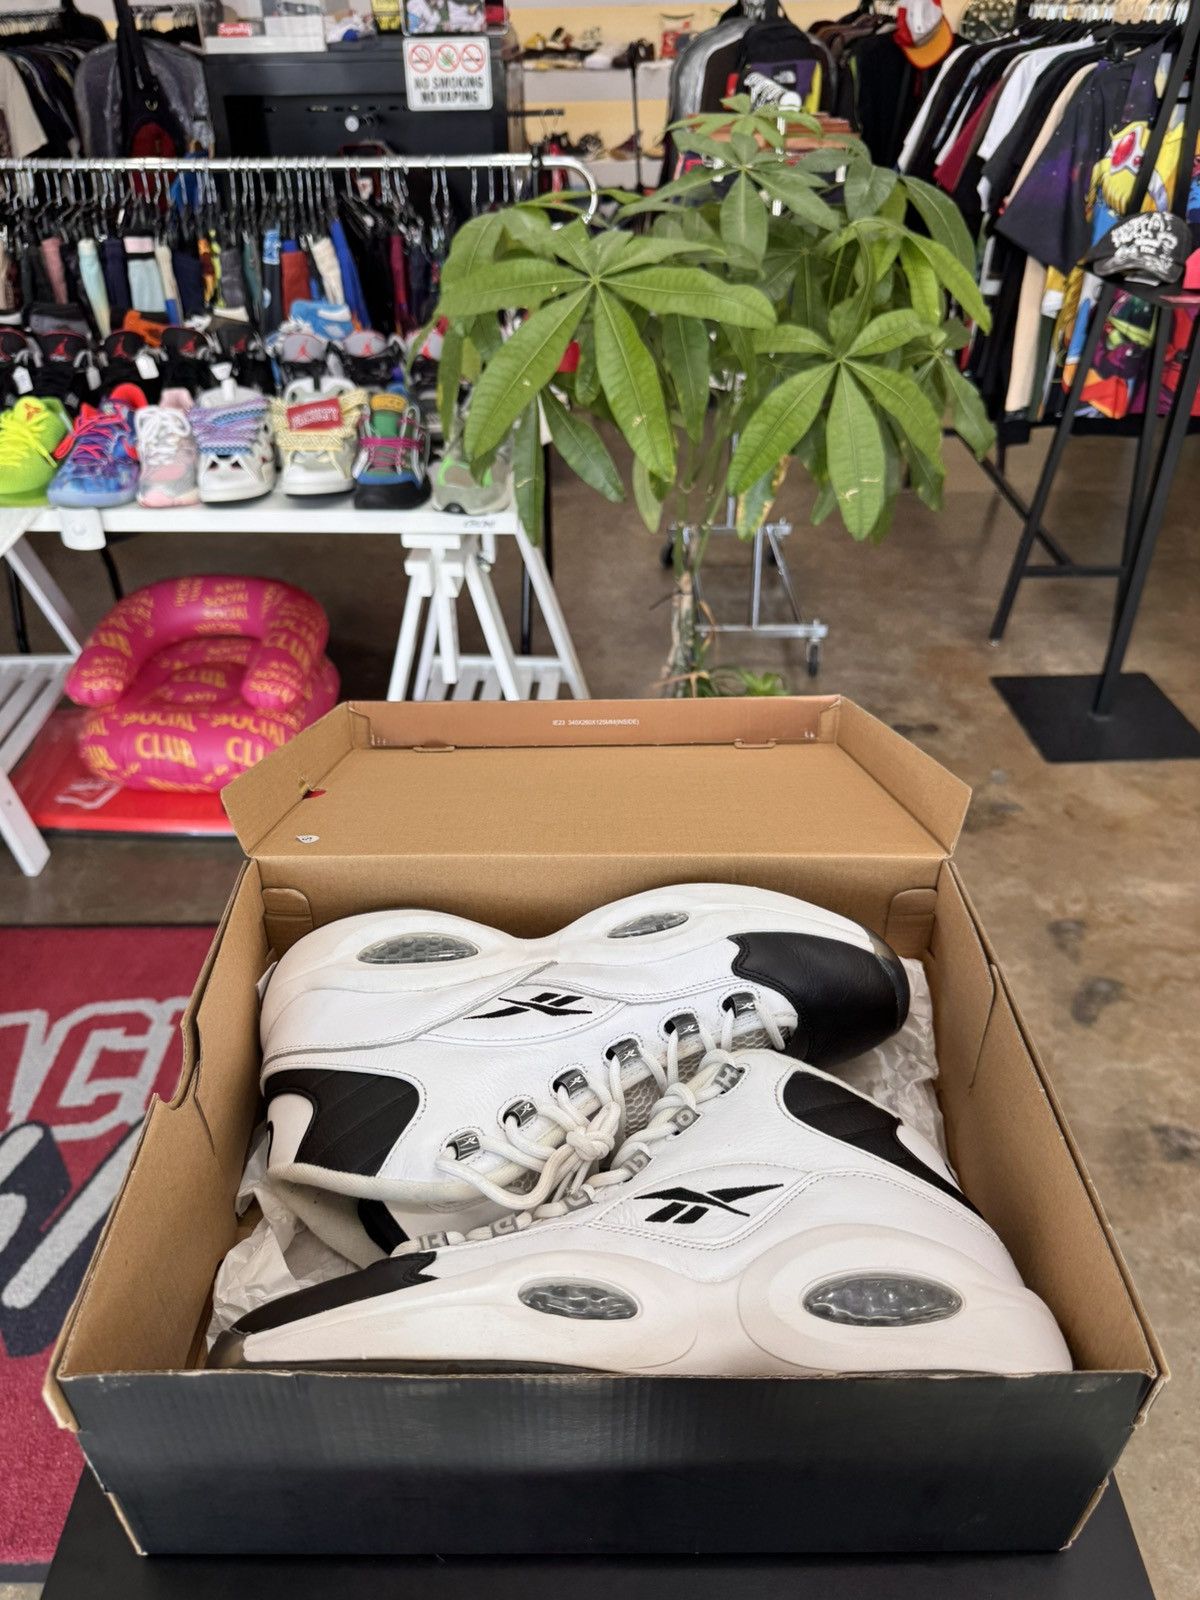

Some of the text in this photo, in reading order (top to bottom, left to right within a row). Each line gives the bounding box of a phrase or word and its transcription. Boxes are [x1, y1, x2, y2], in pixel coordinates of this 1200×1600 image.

[414, 75, 484, 89] NO SMOKING
[420, 90, 479, 104] NO VAPING
[134, 732, 198, 769] CLUB
